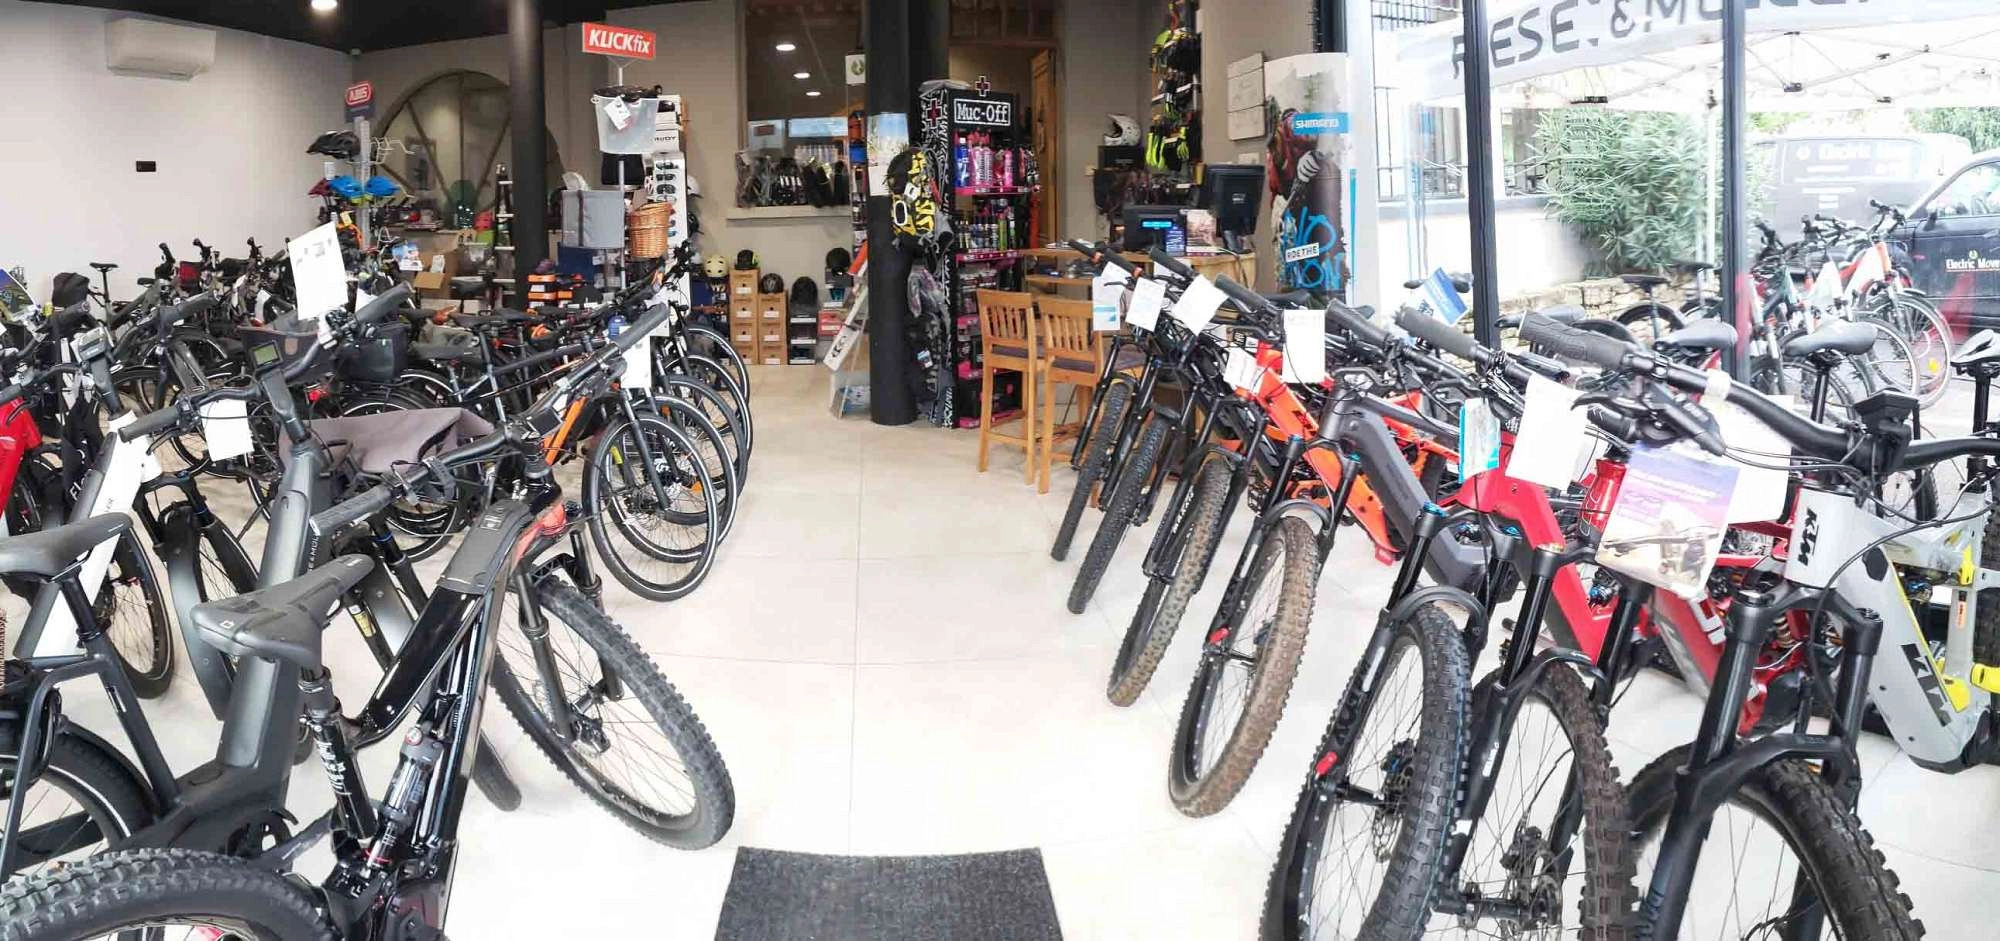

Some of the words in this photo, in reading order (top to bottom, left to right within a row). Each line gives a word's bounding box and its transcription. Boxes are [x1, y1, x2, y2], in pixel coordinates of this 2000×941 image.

[589, 28, 650, 54] KLICKfix
[957, 103, 1008, 122] Muc-Off
[1798, 507, 1818, 567] KTM
